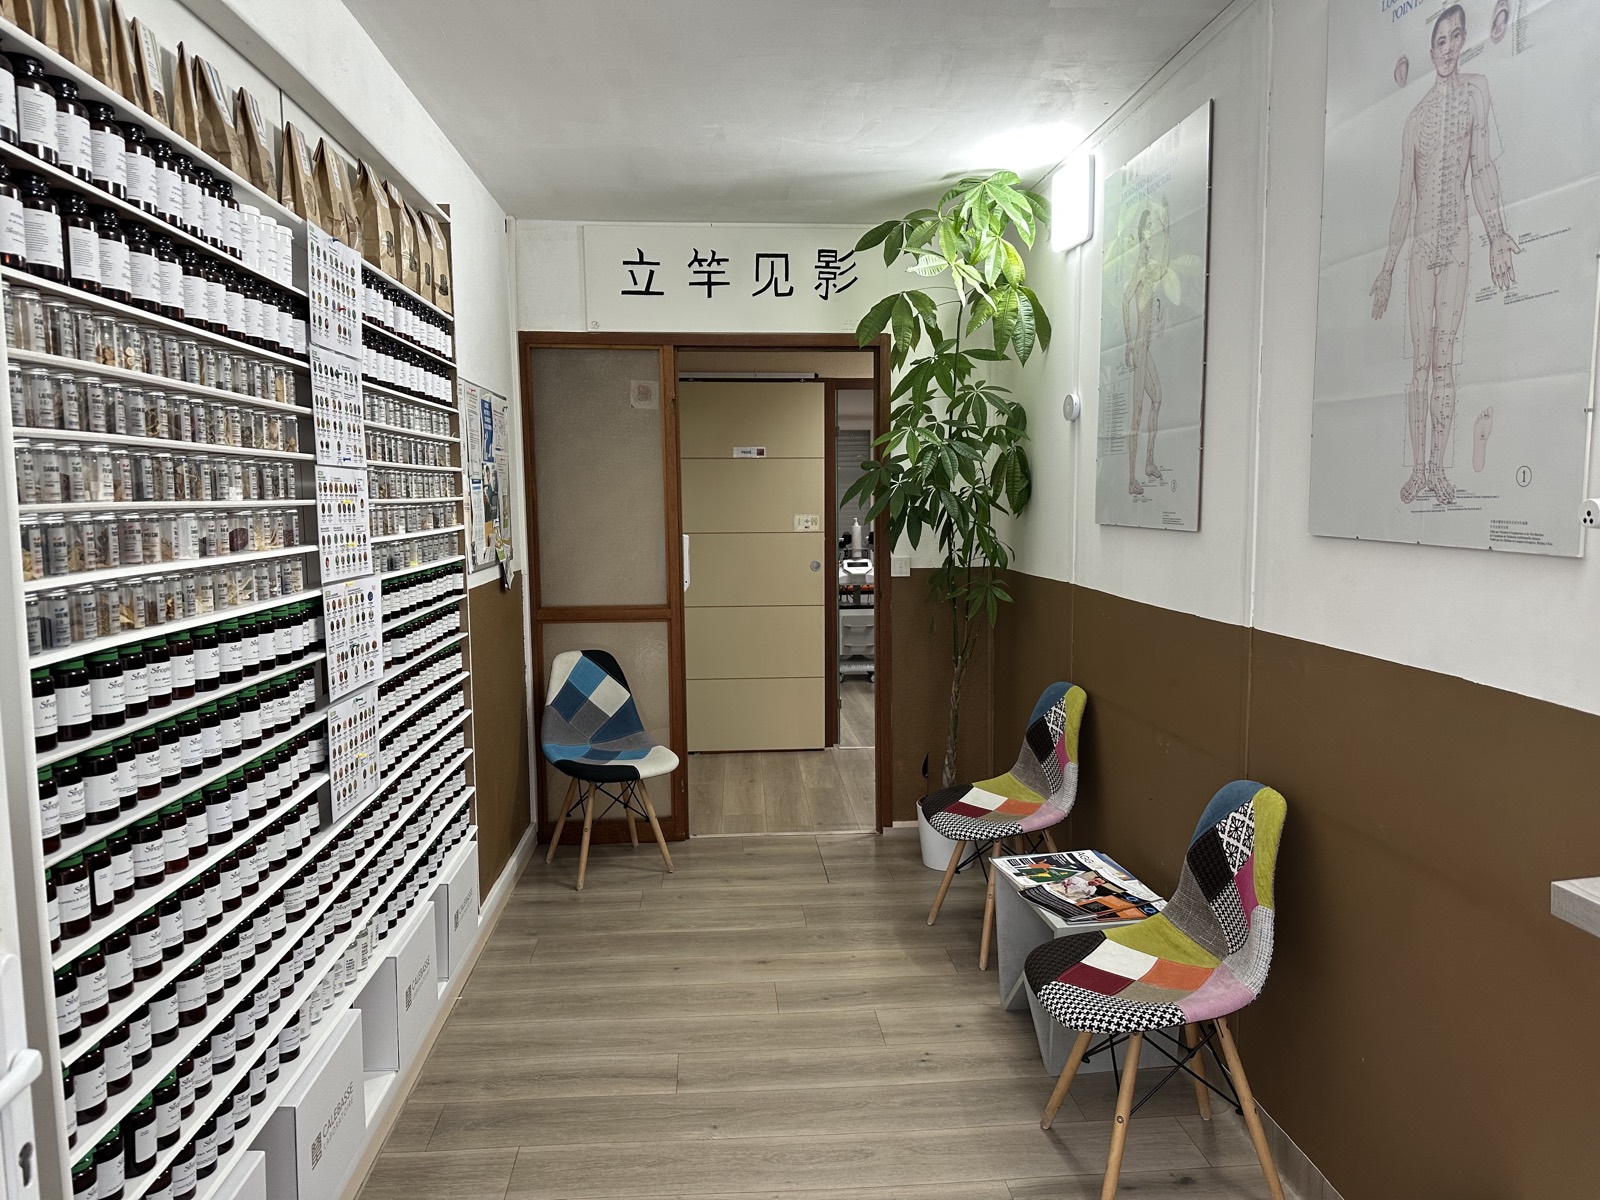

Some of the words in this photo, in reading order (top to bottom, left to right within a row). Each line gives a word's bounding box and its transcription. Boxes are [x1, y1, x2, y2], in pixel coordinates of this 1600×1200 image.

[621, 247, 858, 300] 立竿见影
[322, 1080, 354, 1138] CALEBASSE
[323, 1096, 354, 1150] LABORATOIRE
